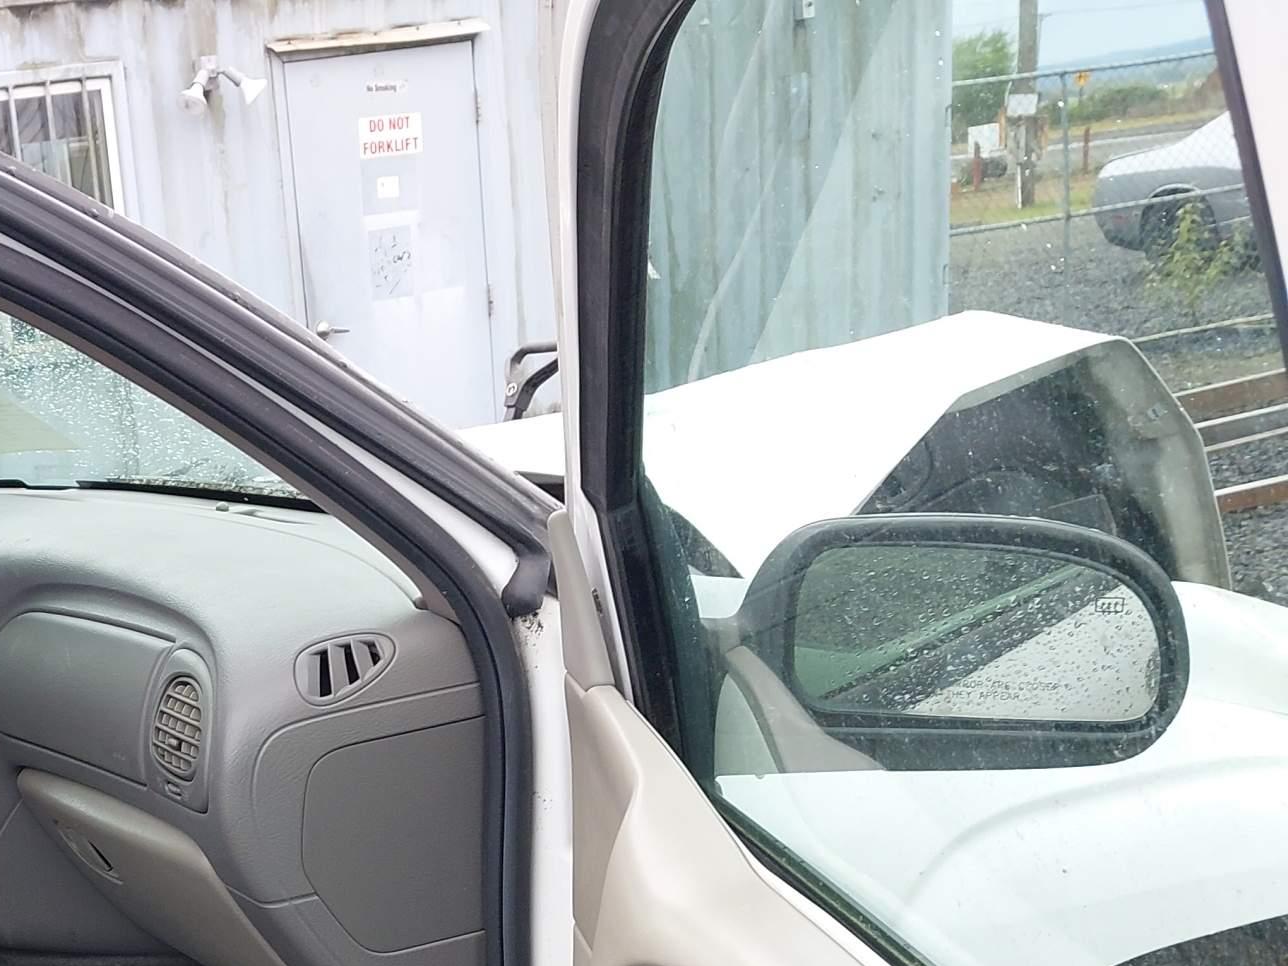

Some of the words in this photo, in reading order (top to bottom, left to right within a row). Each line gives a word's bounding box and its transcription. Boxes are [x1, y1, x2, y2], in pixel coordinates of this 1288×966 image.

[375, 84, 397, 93] Smoking
[369, 119, 384, 133] DO
[388, 116, 409, 130] NOT
[362, 137, 418, 155] FORKLIFT
